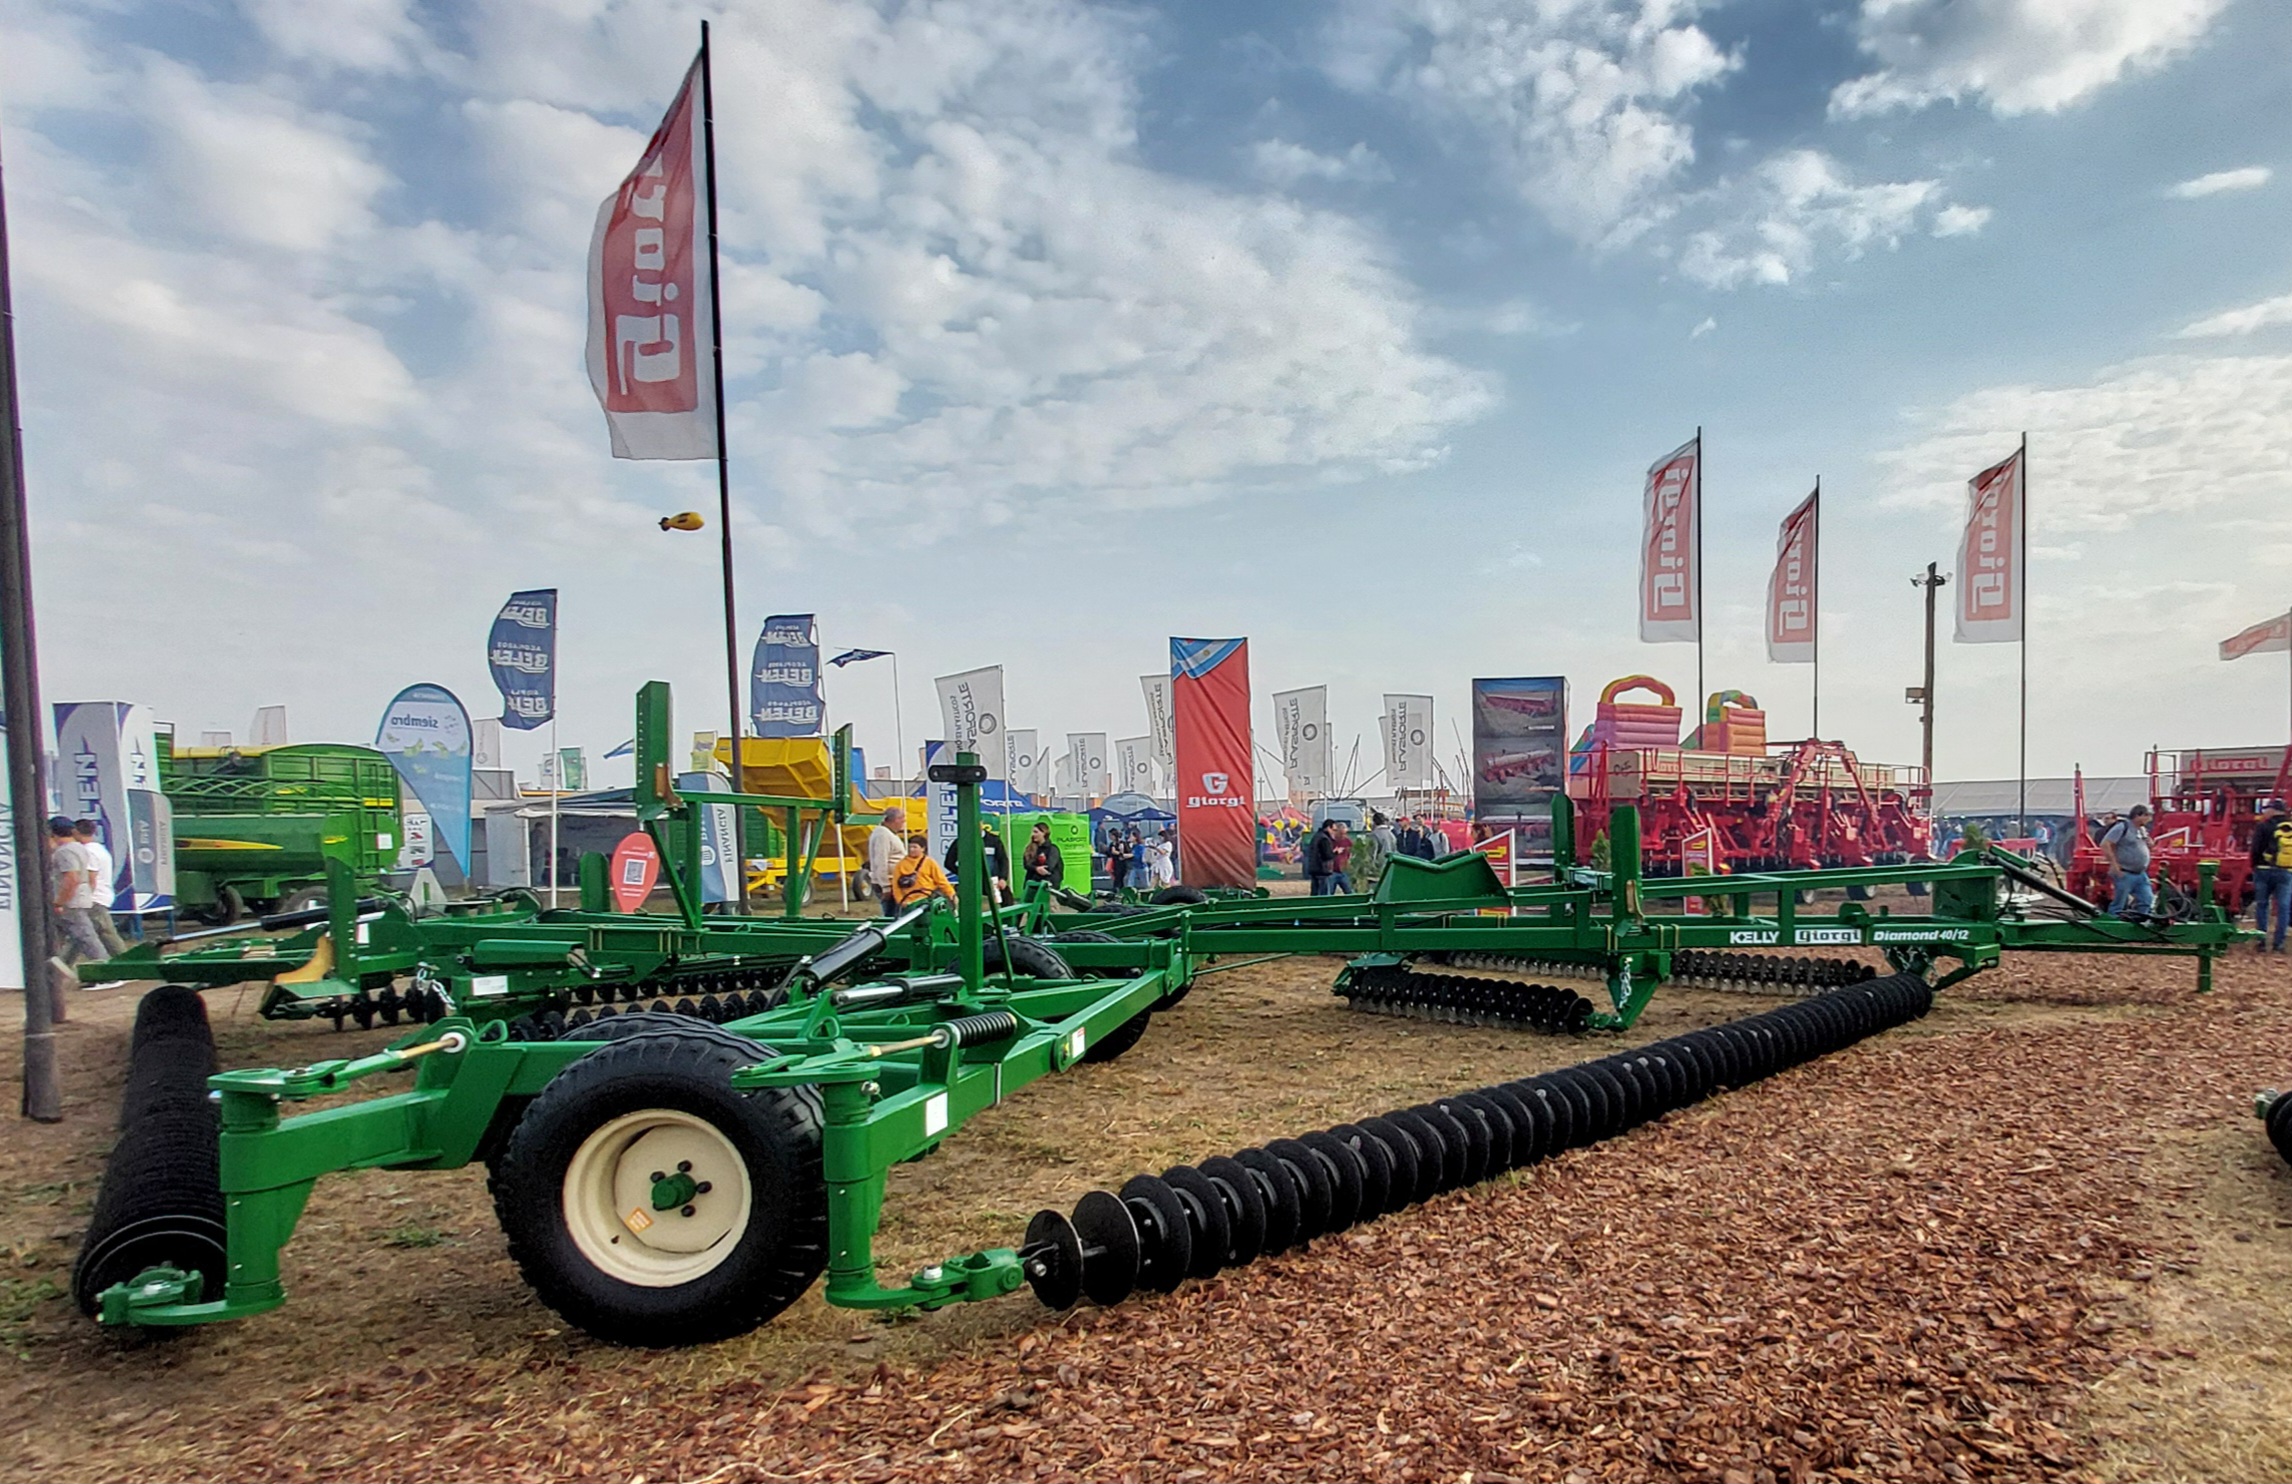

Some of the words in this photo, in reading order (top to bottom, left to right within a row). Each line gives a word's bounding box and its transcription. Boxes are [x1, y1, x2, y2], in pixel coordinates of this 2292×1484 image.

[1730, 931, 1780, 944] KELLY
[1873, 931, 1939, 941] Diamond
[1939, 929, 1969, 941] 40/12
